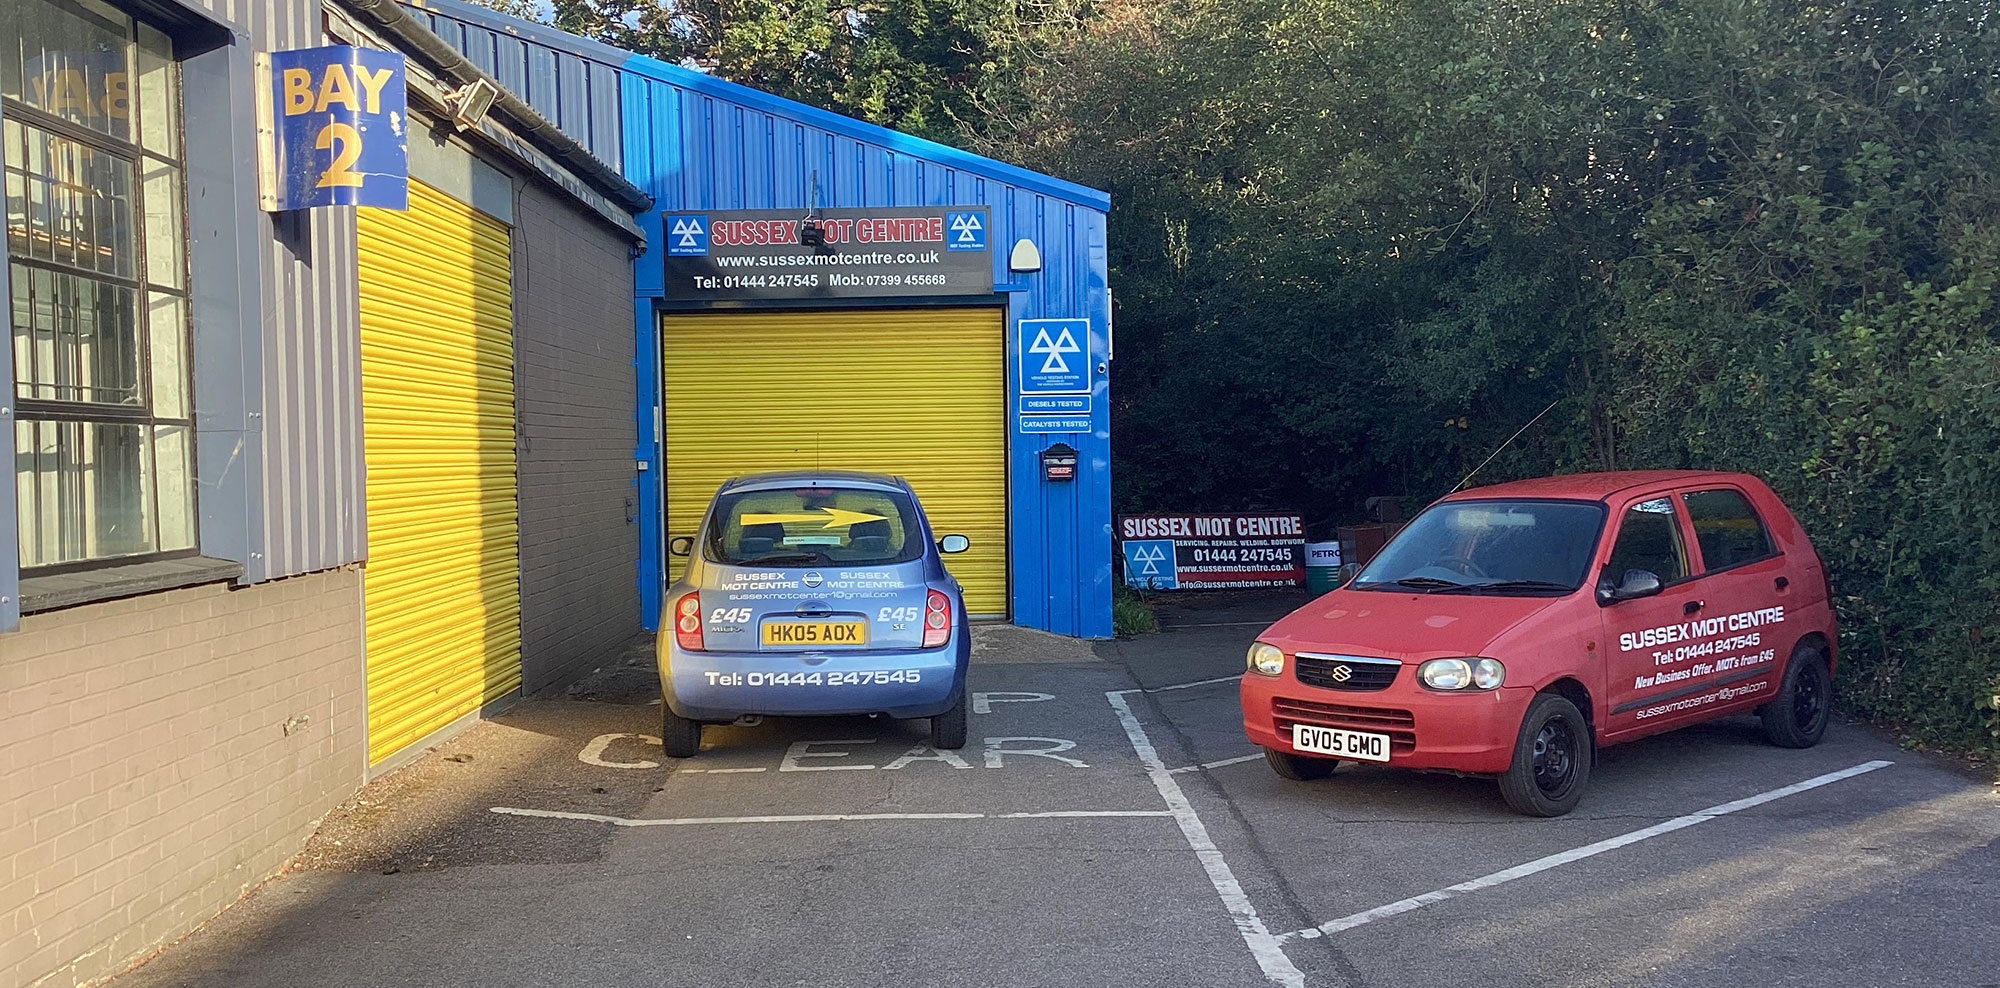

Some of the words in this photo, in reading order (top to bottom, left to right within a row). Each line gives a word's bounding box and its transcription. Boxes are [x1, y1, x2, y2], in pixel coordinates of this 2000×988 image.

[283, 64, 393, 116] BAY
[315, 123, 364, 188] 2
[712, 220, 798, 245] SUSSEX
[856, 218, 943, 243] CENTRE
[716, 250, 939, 267] www.sussexmotcentre.co.uk
[694, 276, 720, 288] Tel:
[724, 275, 765, 288] 01444
[768, 274, 818, 288] 247545
[829, 274, 864, 286] Mob:
[867, 275, 900, 286] 07399
[904, 274, 946, 285] 455668
[1123, 518, 1191, 537] SUSSEX
[1195, 517, 1231, 536] MOT
[1236, 516, 1302, 536] CENTRE
[1194, 549, 1236, 562] 01444
[1241, 549, 1292, 561] 247545
[1312, 549, 1341, 558] PETRO
[840, 571, 890, 580] SUSSEX
[1177, 563, 1294, 573] www.sussexmotcentre.co.uk
[735, 572, 786, 581] SUSSEX
[827, 580, 854, 589] MOT
[855, 580, 904, 589] CENTRE
[721, 583, 747, 591] MOT
[750, 582, 799, 590] CENTRE
[729, 591, 897, 600] sussexmotcenter1@gmail.com
[709, 607, 752, 624] £45
[877, 607, 918, 622] £45
[771, 625, 817, 641] HK05
[822, 625, 857, 641] AOX
[1620, 622, 1690, 651] SUSSEX
[1692, 616, 1726, 638] MOT
[1728, 606, 1784, 632] CENTRE
[1653, 650, 1673, 665] Tel:
[1675, 645, 1713, 662] 01444
[1715, 633, 1760, 653] 247545
[1634, 676, 1653, 689] New
[1655, 668, 1690, 685] Business
[1692, 664, 1715, 679] Offer.
[1716, 656, 1739, 671] MOT's
[1741, 654, 1758, 666] from
[1759, 649, 1774, 663] £45
[705, 671, 742, 686] Tel:
[747, 671, 822, 686] 01444
[828, 670, 921, 685] 247545
[1636, 680, 1767, 720] sussexmotcenter1@gmail.com
[1301, 728, 1342, 751] GV05
[1348, 735, 1381, 756] GMO
